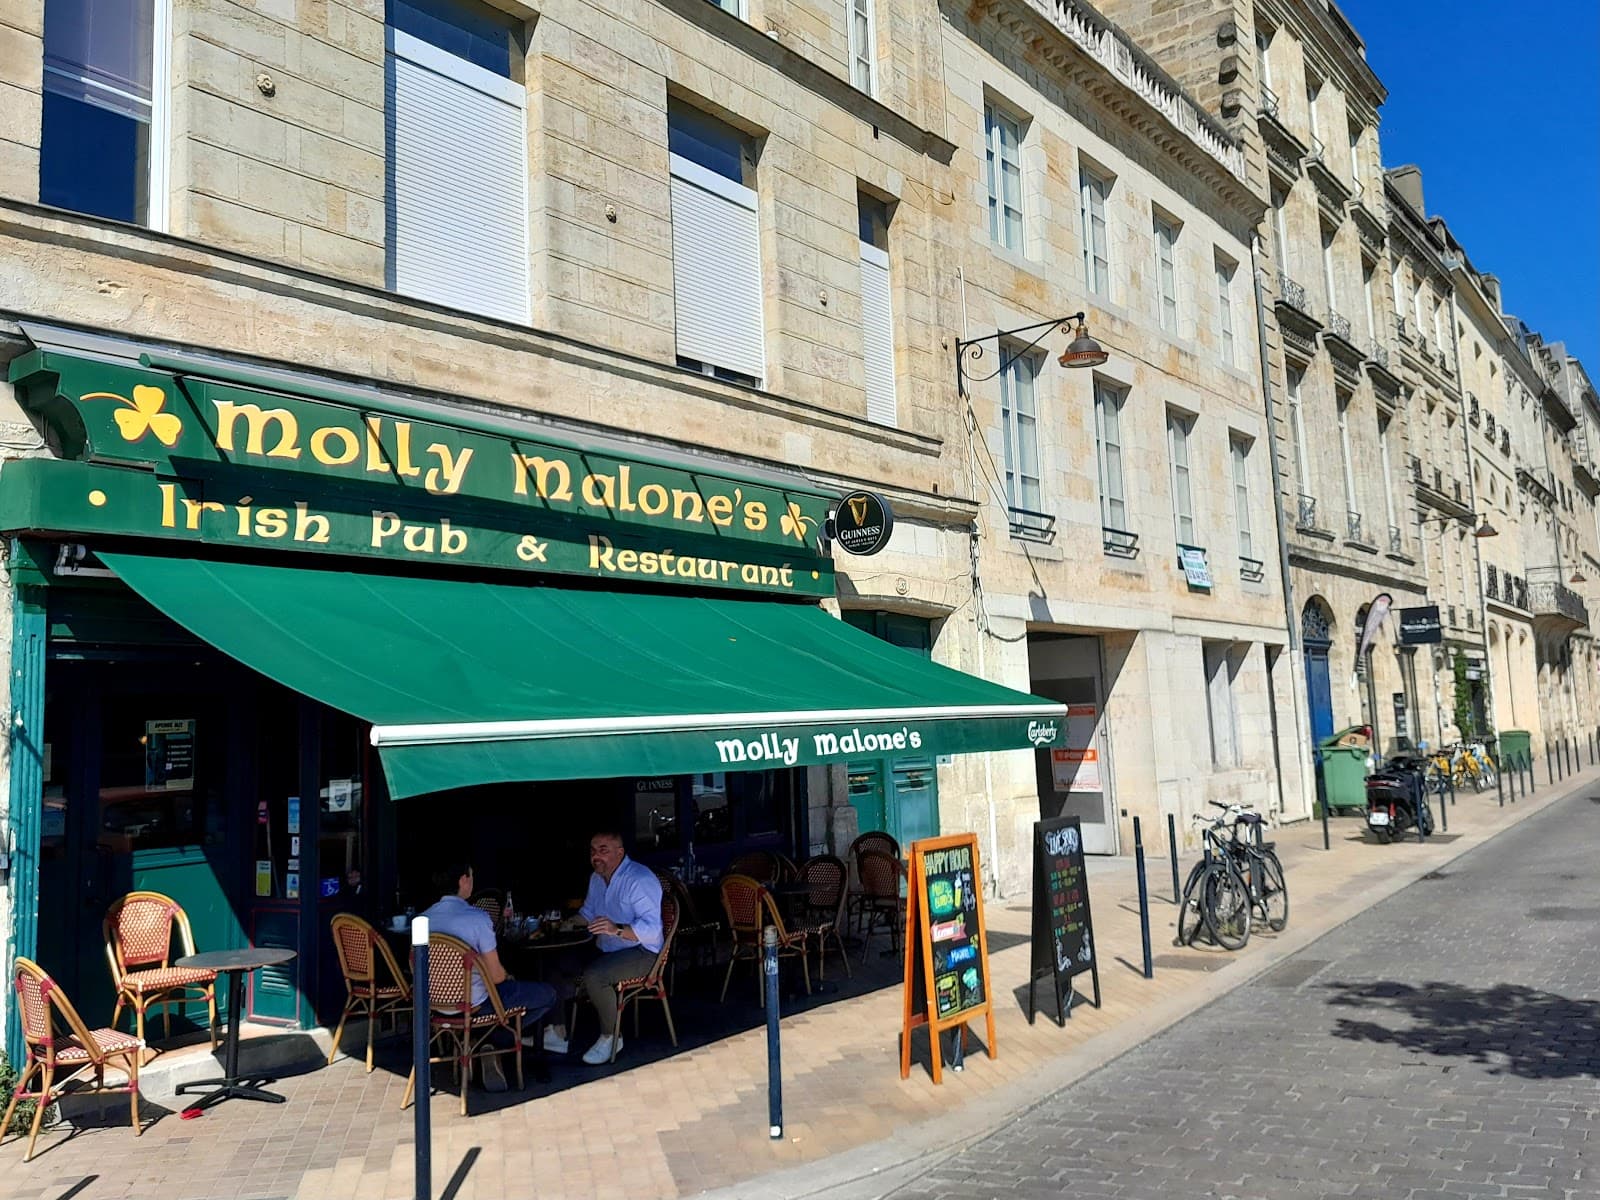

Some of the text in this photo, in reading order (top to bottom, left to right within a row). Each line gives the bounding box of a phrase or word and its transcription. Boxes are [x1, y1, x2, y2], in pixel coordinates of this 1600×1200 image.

[211, 399, 768, 532] Molly Malone's
[158, 483, 794, 588] Irish Pub & Restaurant
[840, 525, 881, 541] GUINNESS
[715, 727, 922, 766] Molly Malone's
[1027, 720, 1058, 746] Carlsberg
[924, 847, 971, 877] HAPPY HOUR
